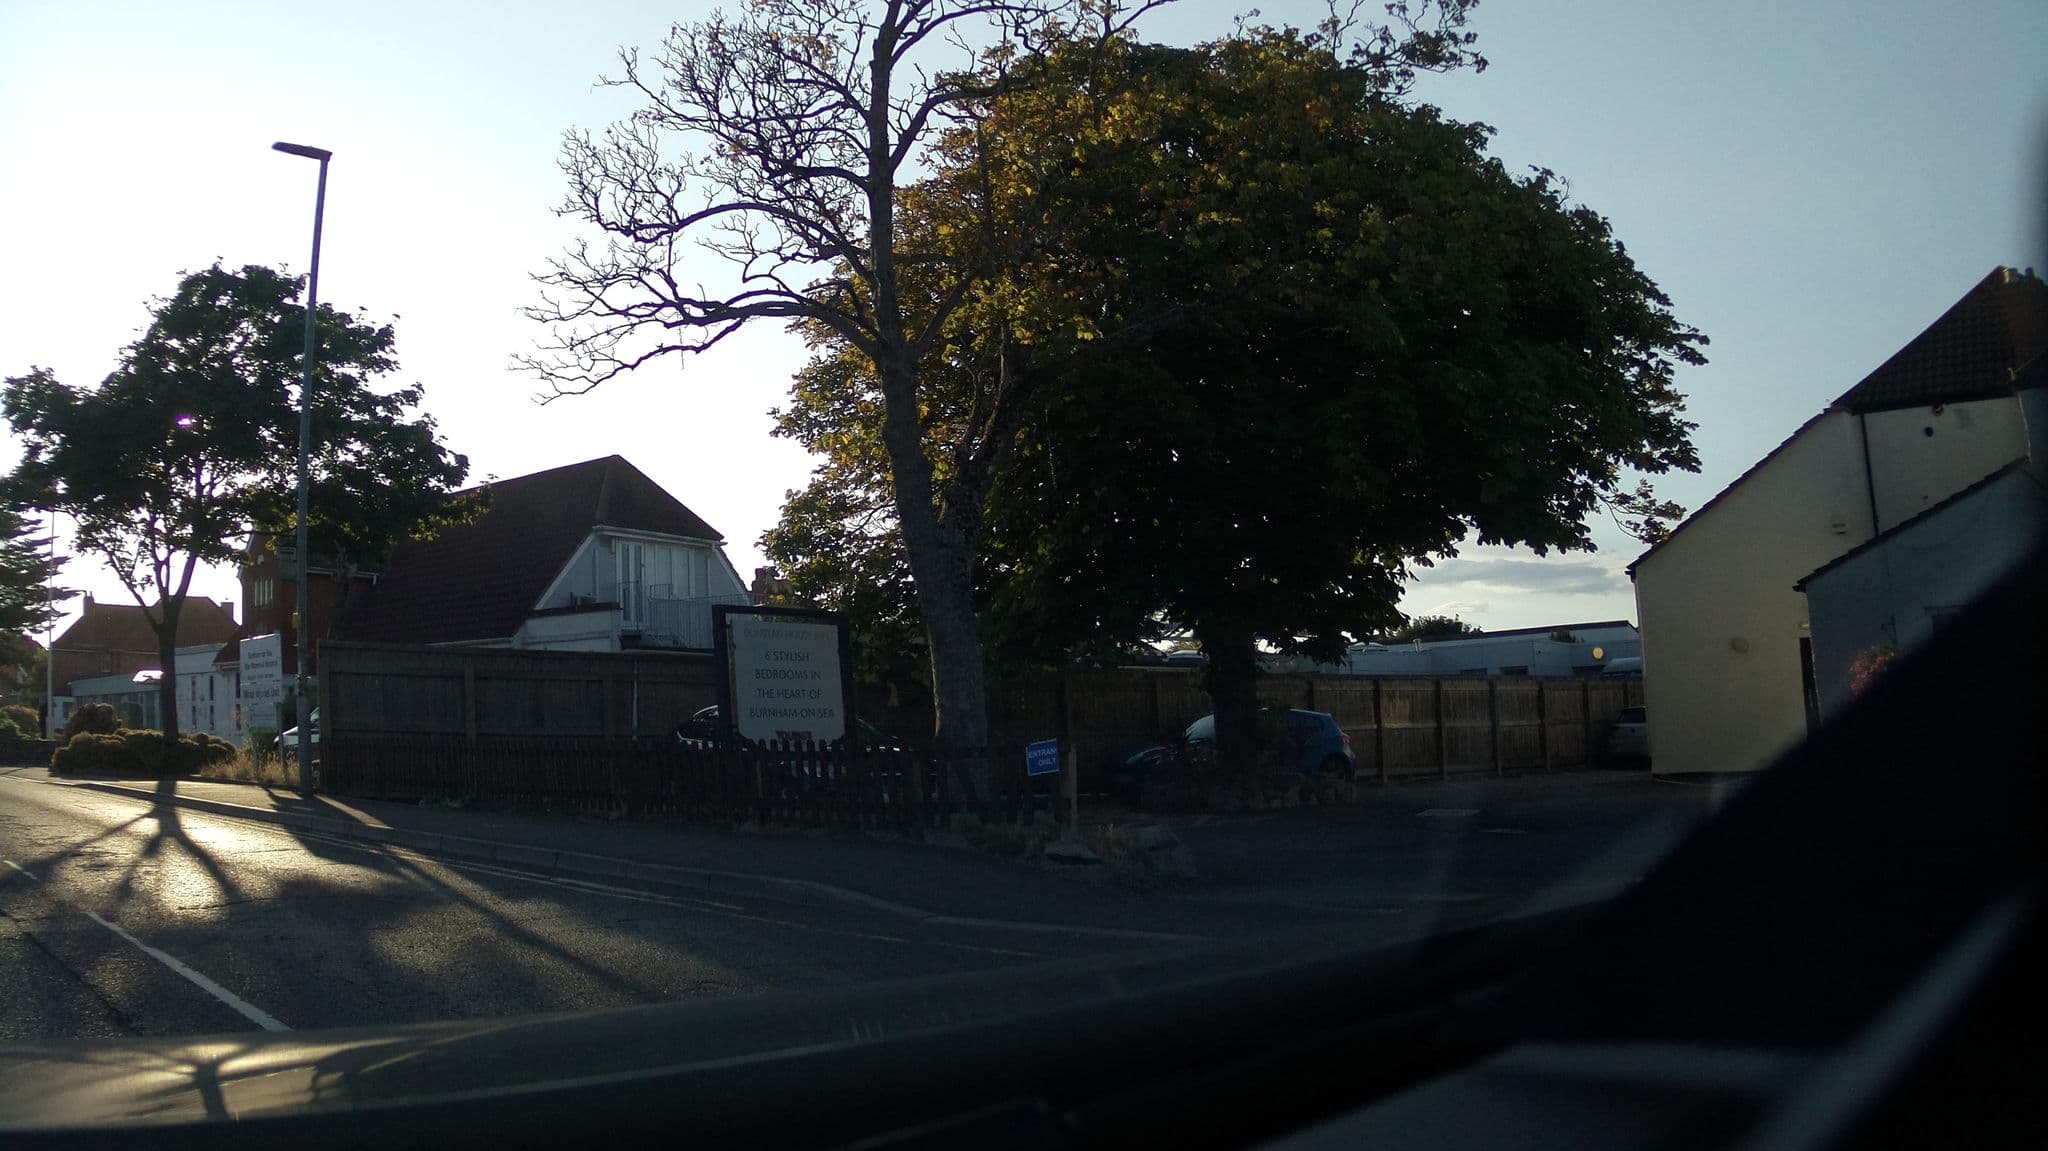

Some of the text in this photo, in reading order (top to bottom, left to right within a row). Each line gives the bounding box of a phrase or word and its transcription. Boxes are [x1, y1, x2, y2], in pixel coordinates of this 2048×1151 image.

[773, 651, 809, 662] STYLISH
[755, 669, 821, 680] BEDROOMS IN
[757, 688, 823, 699] THE HEART OF
